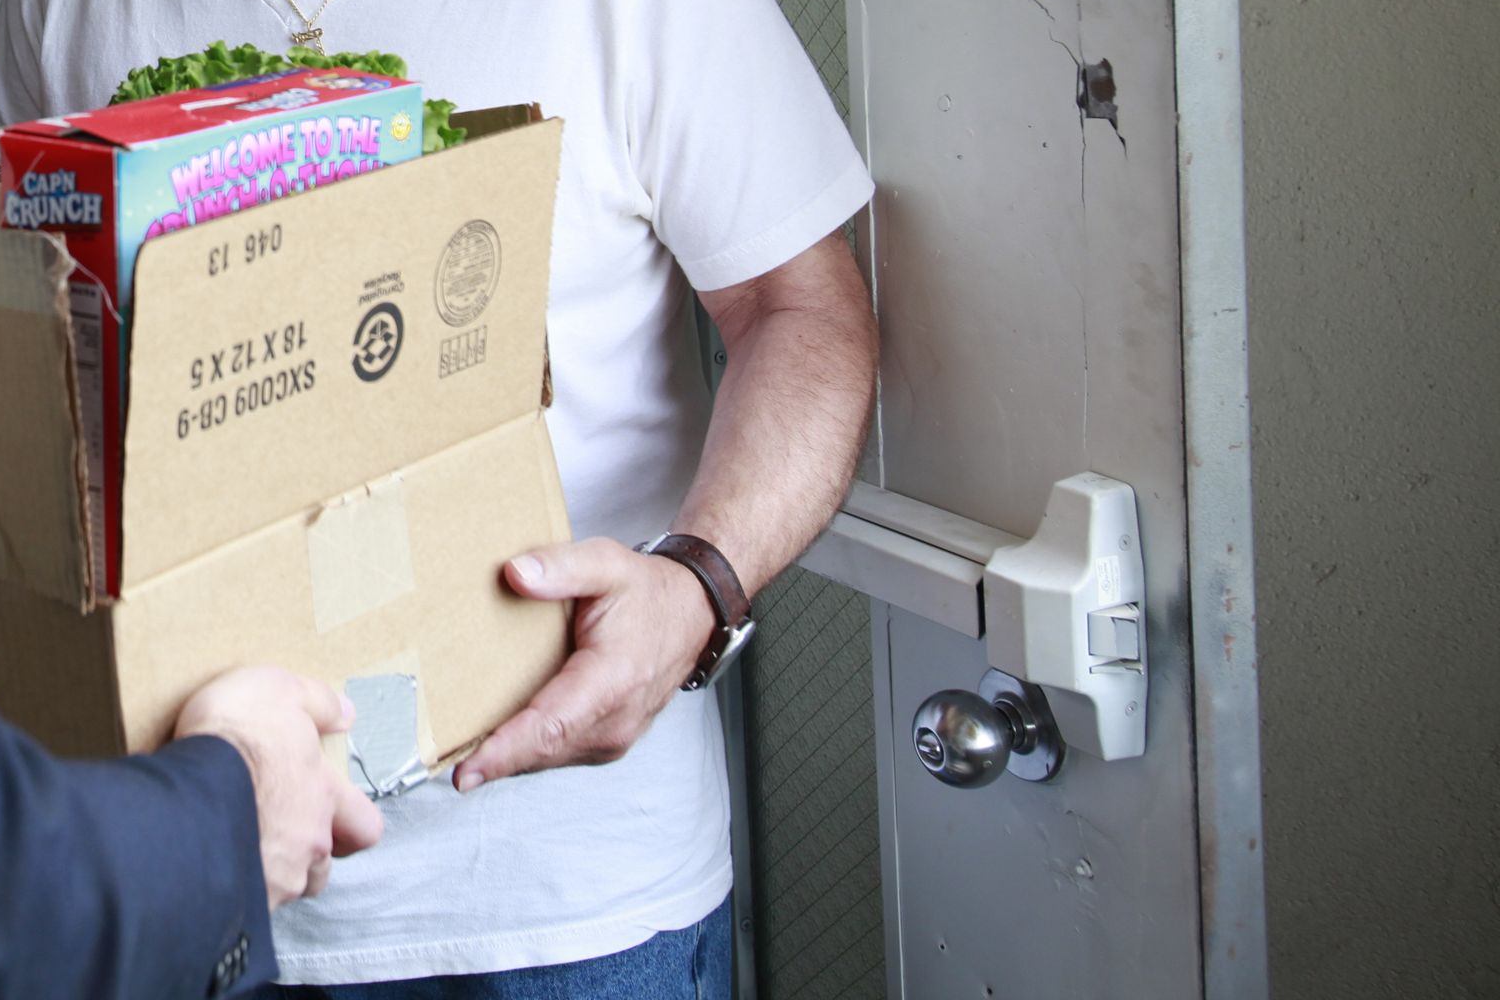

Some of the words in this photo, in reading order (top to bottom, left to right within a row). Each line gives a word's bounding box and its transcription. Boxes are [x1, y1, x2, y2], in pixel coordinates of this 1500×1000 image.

[170, 122, 296, 204] WELCOME
[300, 116, 333, 159] TO
[336, 115, 382, 156] THE
[22, 168, 77, 197] CAP'N
[4, 189, 104, 229] CRUNCH
[208, 243, 230, 277] 13
[245, 223, 283, 264] 046
[263, 331, 278, 363] X
[283, 321, 308, 354] 18
[190, 358, 204, 390] 5
[210, 350, 225, 383] X
[231, 340, 256, 374] 12
[176, 394, 228, 440] CB-9
